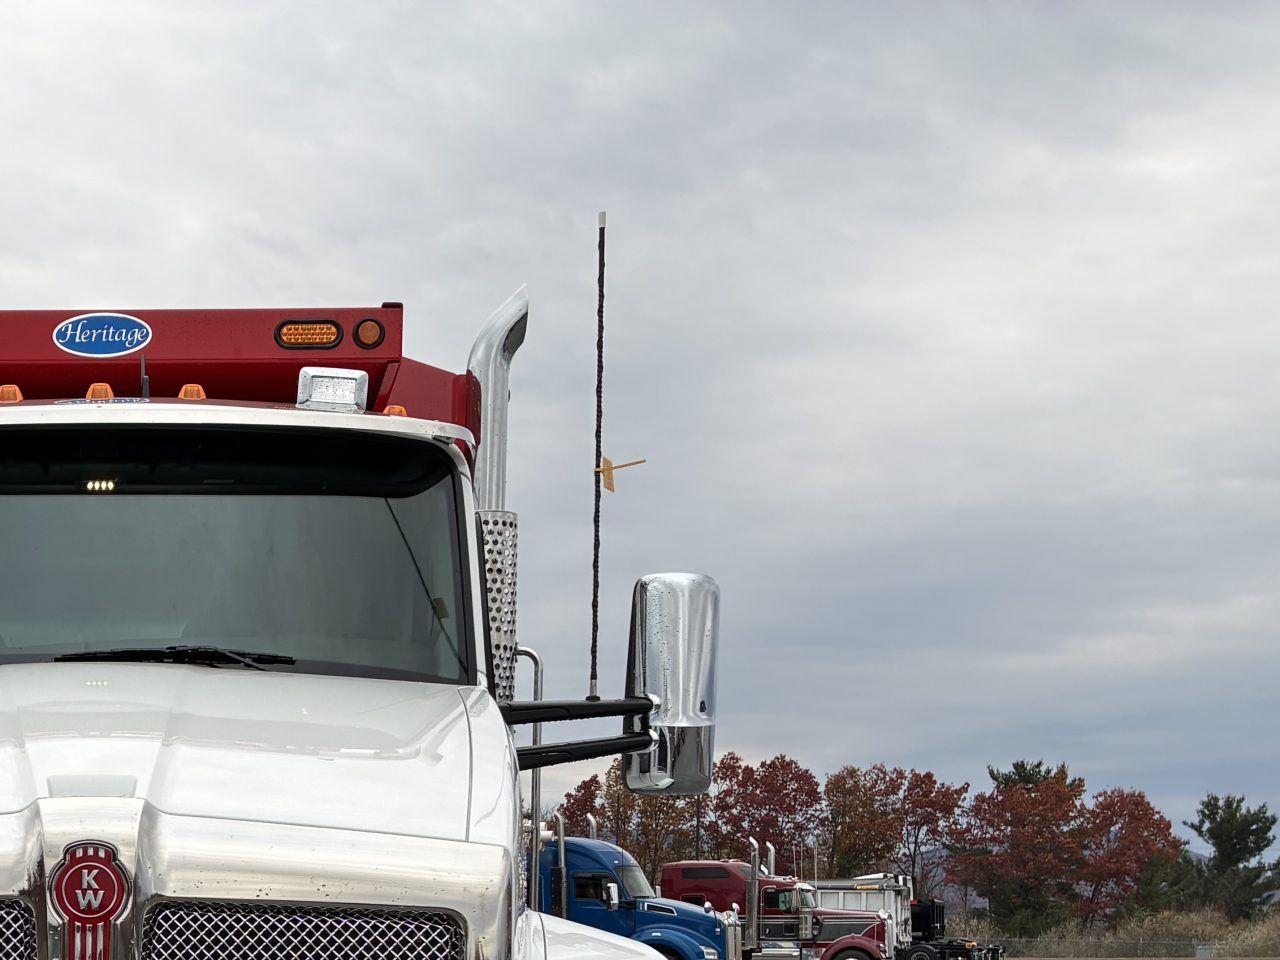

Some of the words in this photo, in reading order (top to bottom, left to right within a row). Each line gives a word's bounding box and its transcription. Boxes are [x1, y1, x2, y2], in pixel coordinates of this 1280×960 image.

[58, 320, 147, 348] Heritage
[81, 869, 100, 889] K
[75, 889, 105, 910] W
